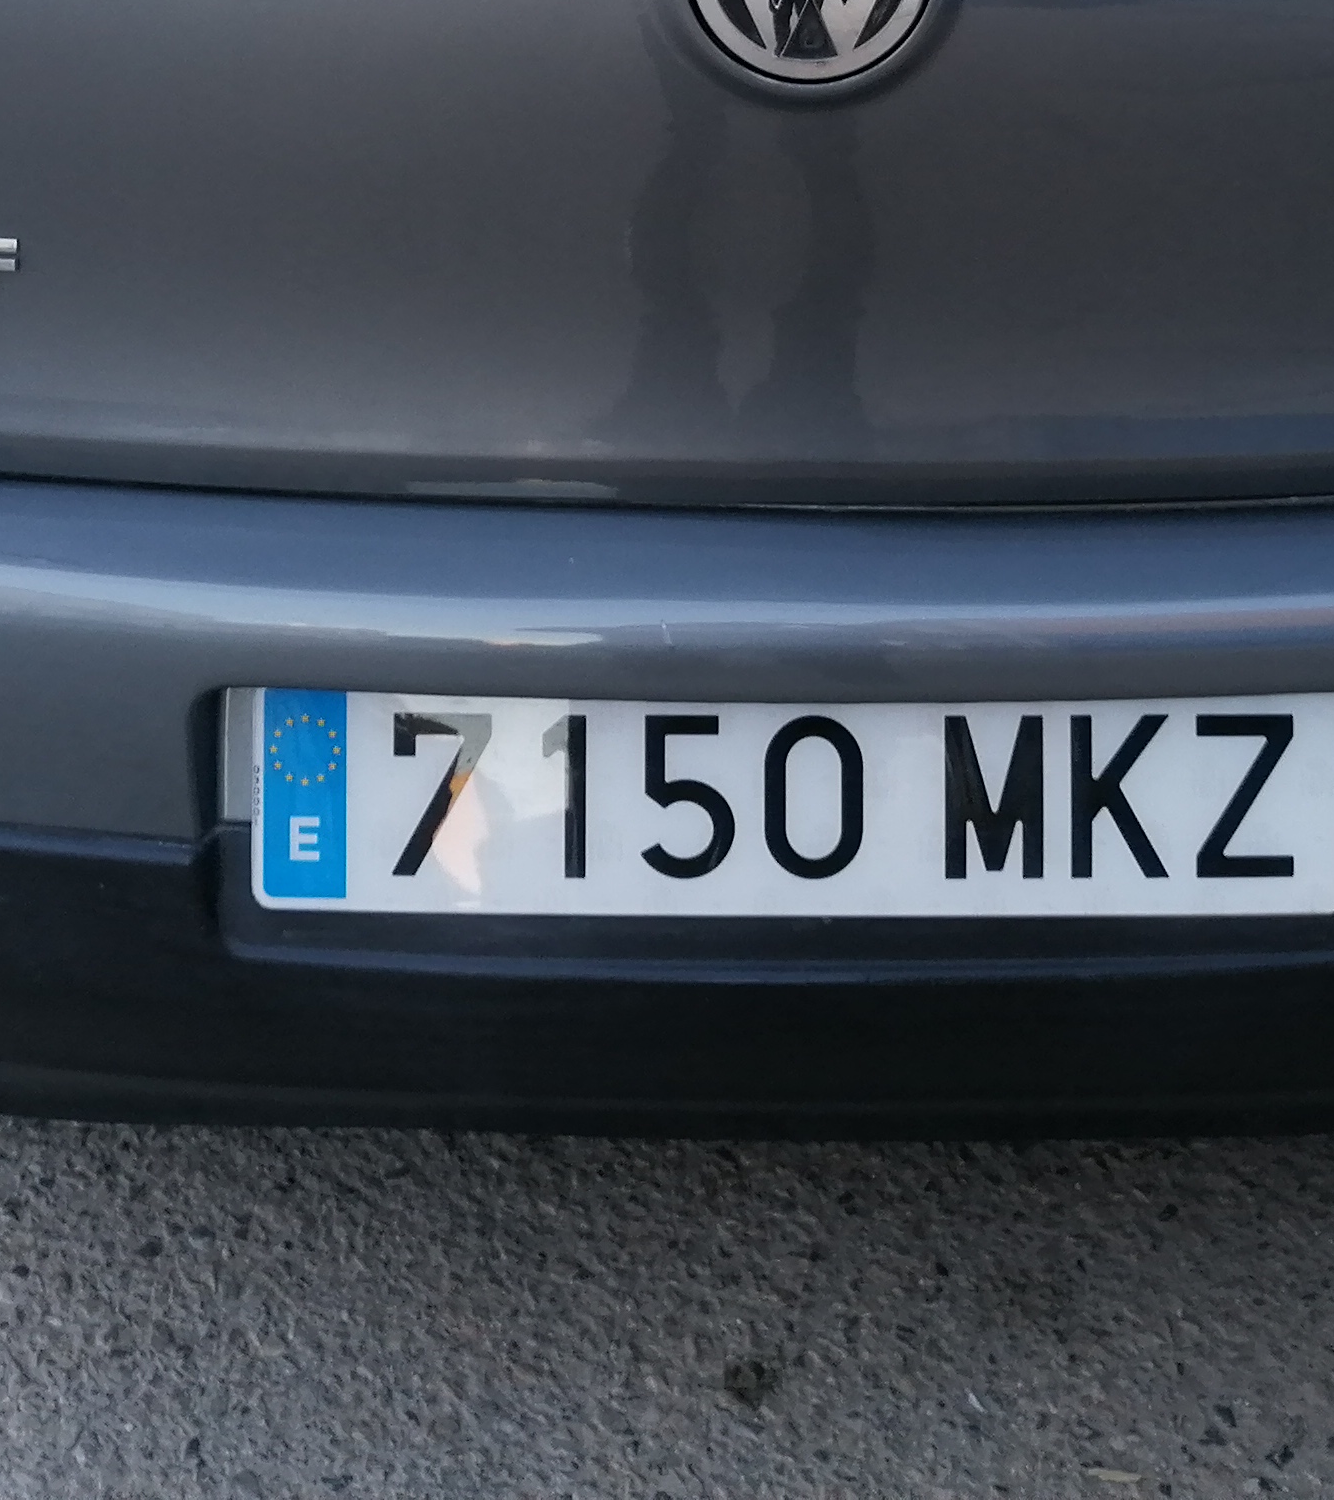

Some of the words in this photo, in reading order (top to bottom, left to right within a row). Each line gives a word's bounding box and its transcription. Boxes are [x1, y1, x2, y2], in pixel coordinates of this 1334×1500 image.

[289, 816, 320, 861] E
[392, 712, 864, 880] 7150
[944, 713, 1295, 879] MKZ
